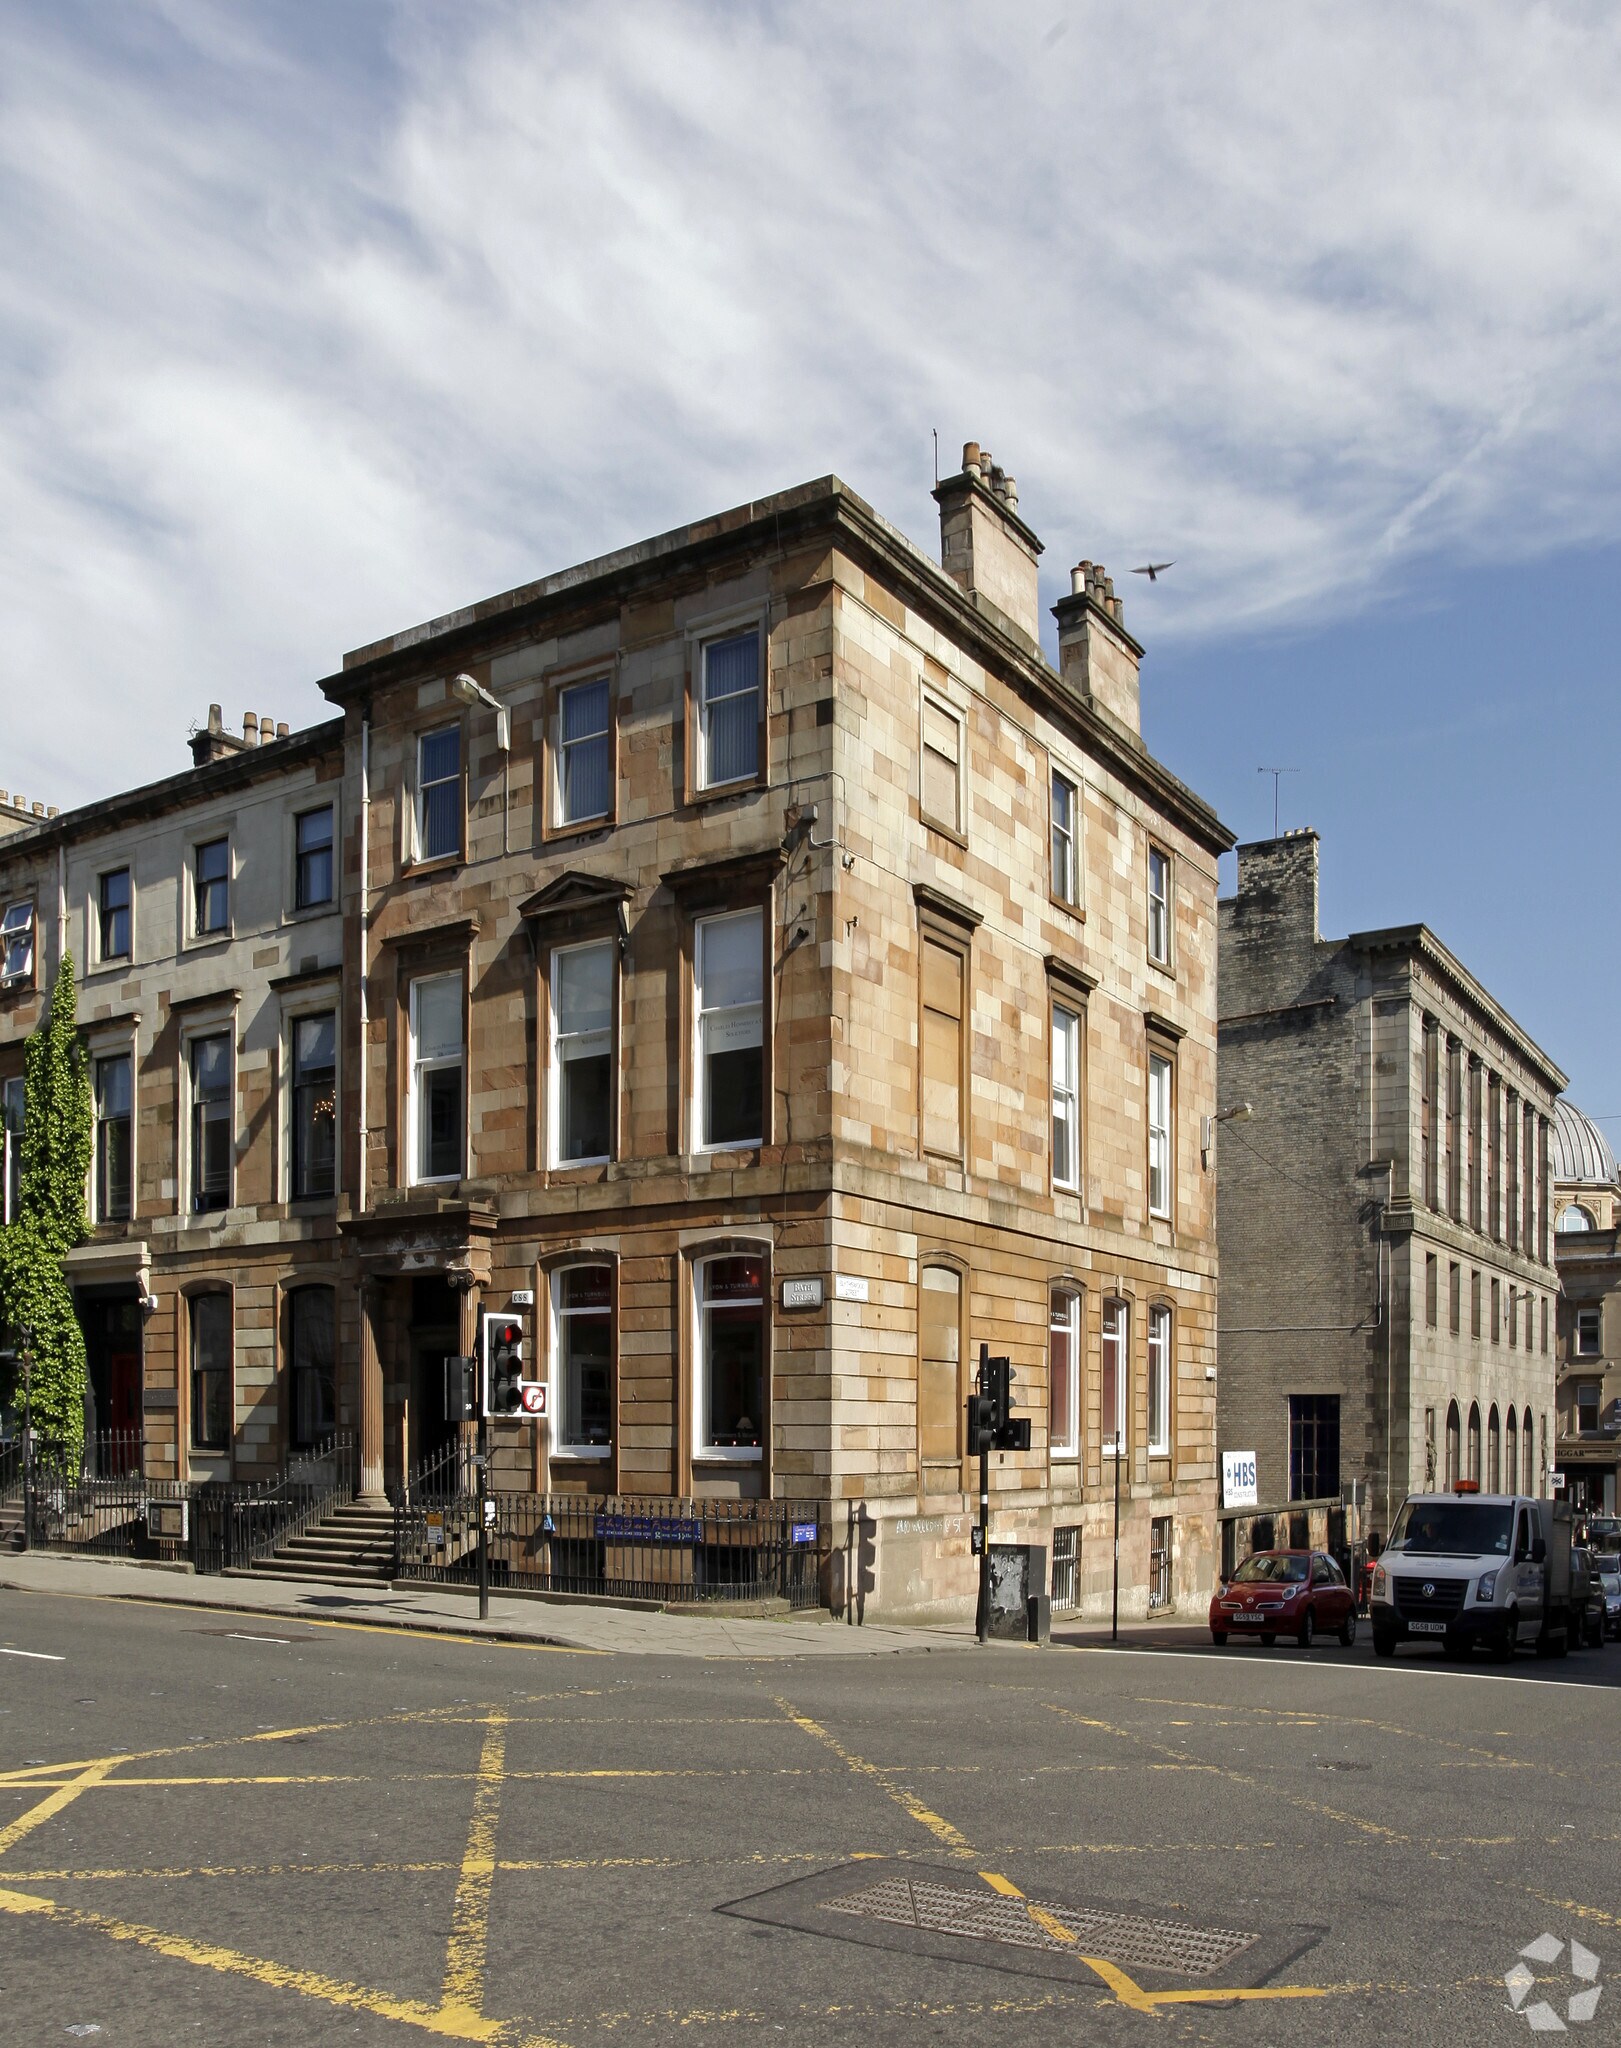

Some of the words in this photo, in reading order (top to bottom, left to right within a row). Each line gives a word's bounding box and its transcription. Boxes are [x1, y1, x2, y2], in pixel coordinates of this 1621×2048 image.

[794, 1282, 813, 1292] BATH
[791, 1292, 817, 1302] STREET
[1234, 1462, 1255, 1487] HBS
